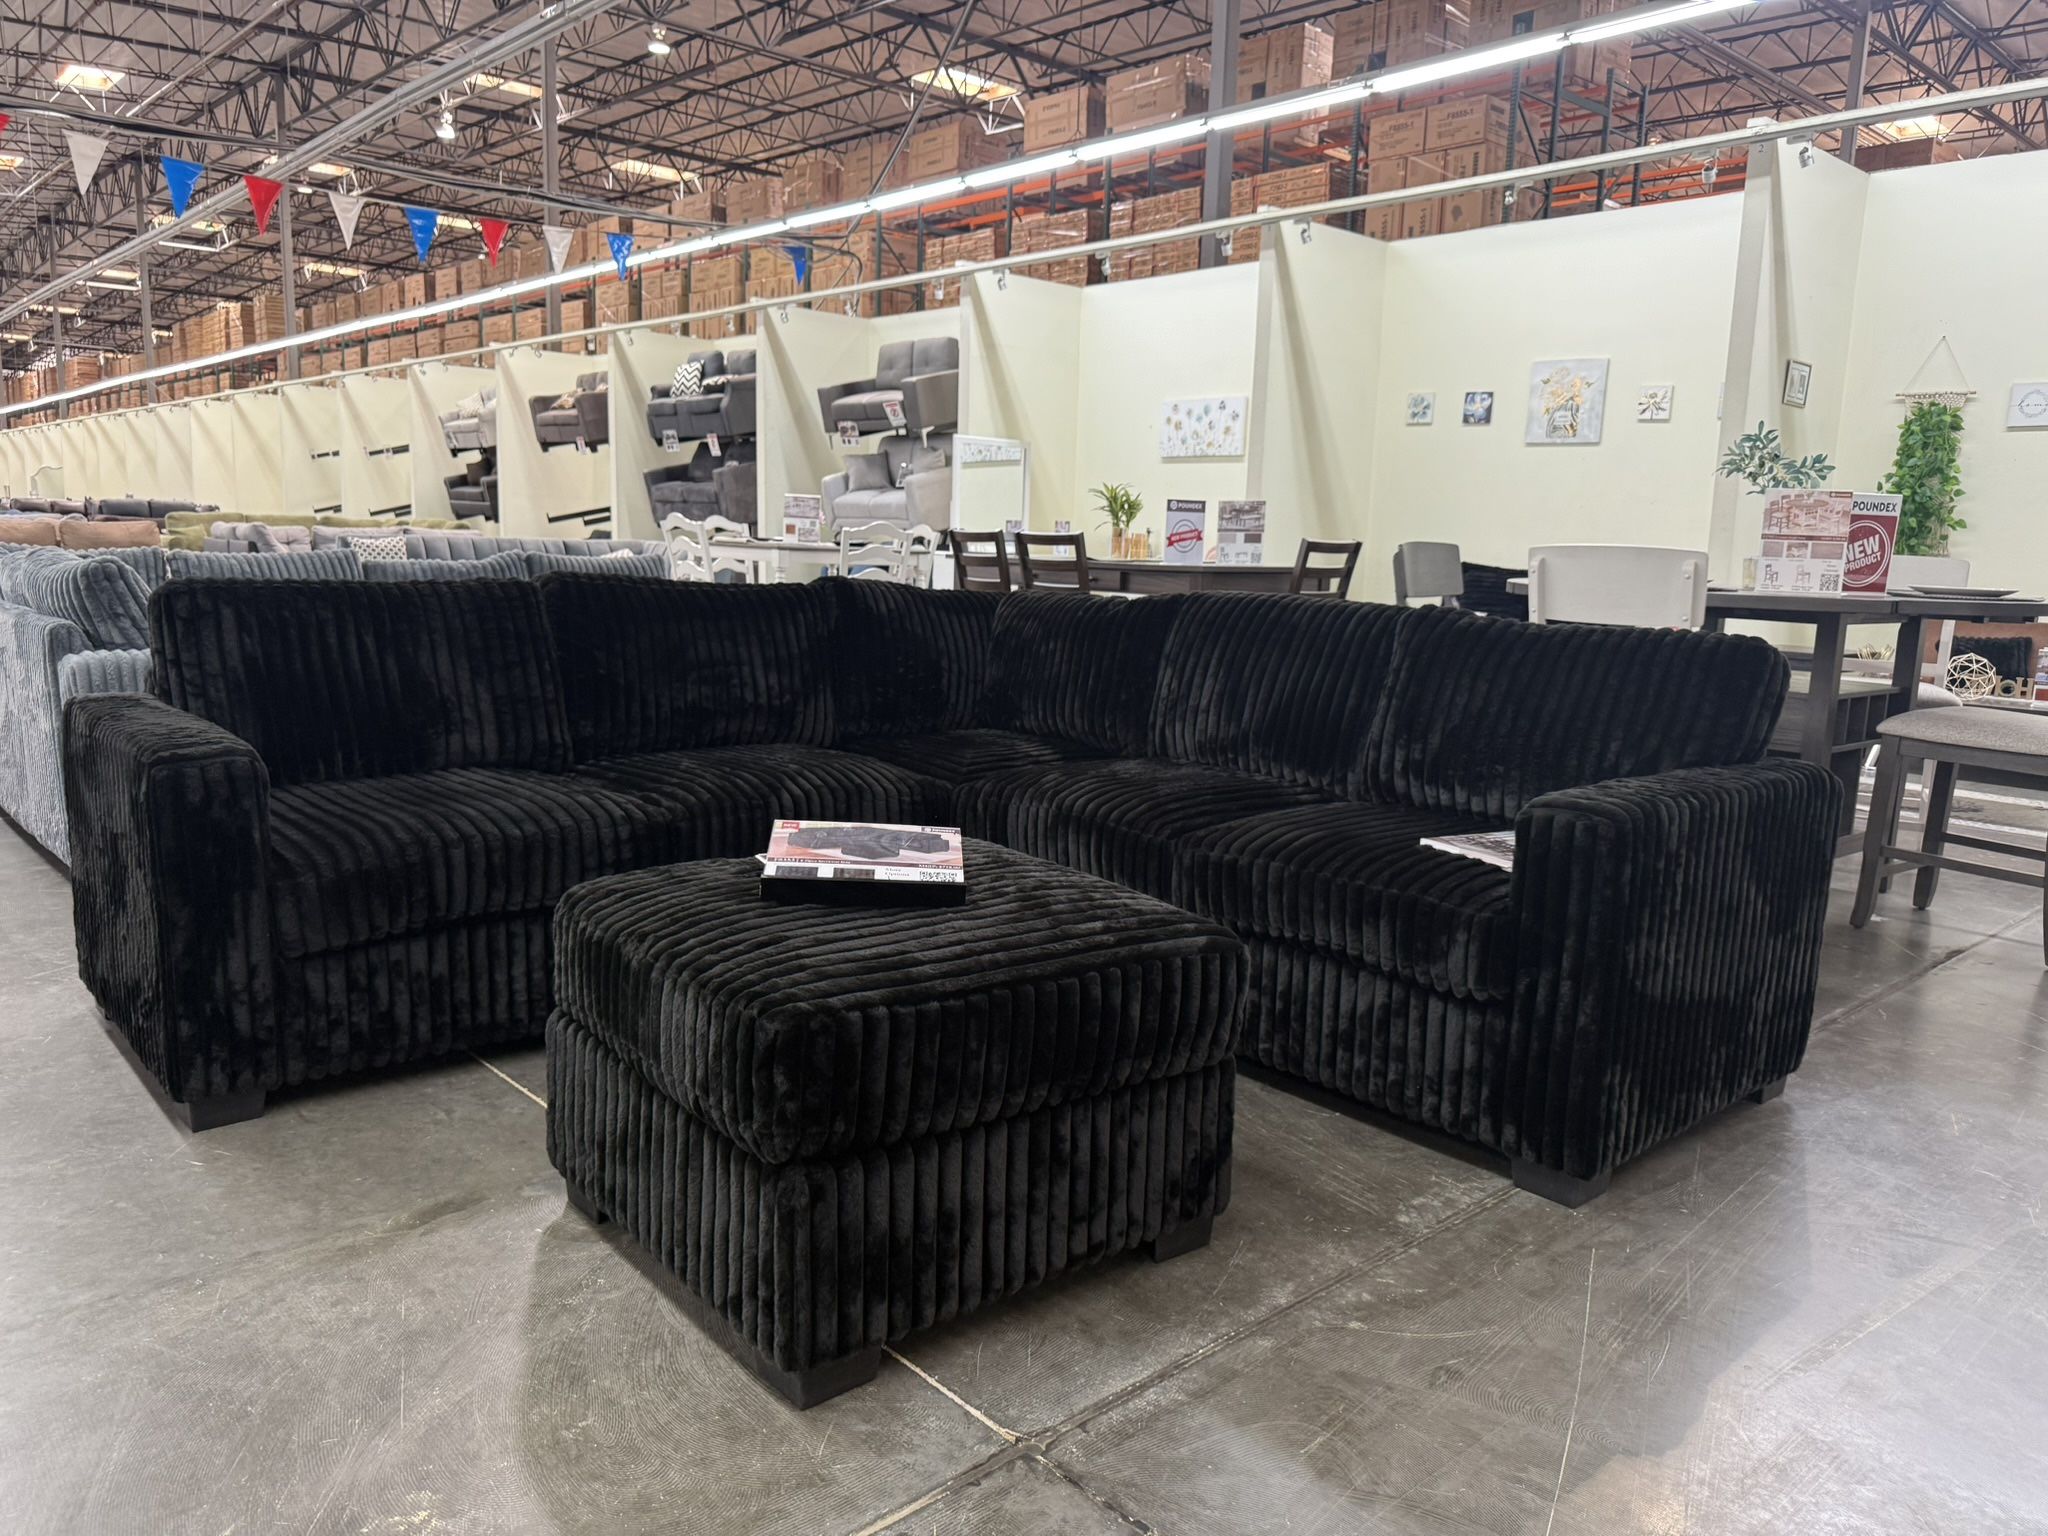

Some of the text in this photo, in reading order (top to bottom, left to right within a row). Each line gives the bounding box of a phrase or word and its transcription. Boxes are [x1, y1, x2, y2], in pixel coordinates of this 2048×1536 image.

[1852, 501, 1897, 513] POUNDEX
[1845, 534, 1880, 563] NEW
[1844, 552, 1882, 573] PRODUCT
